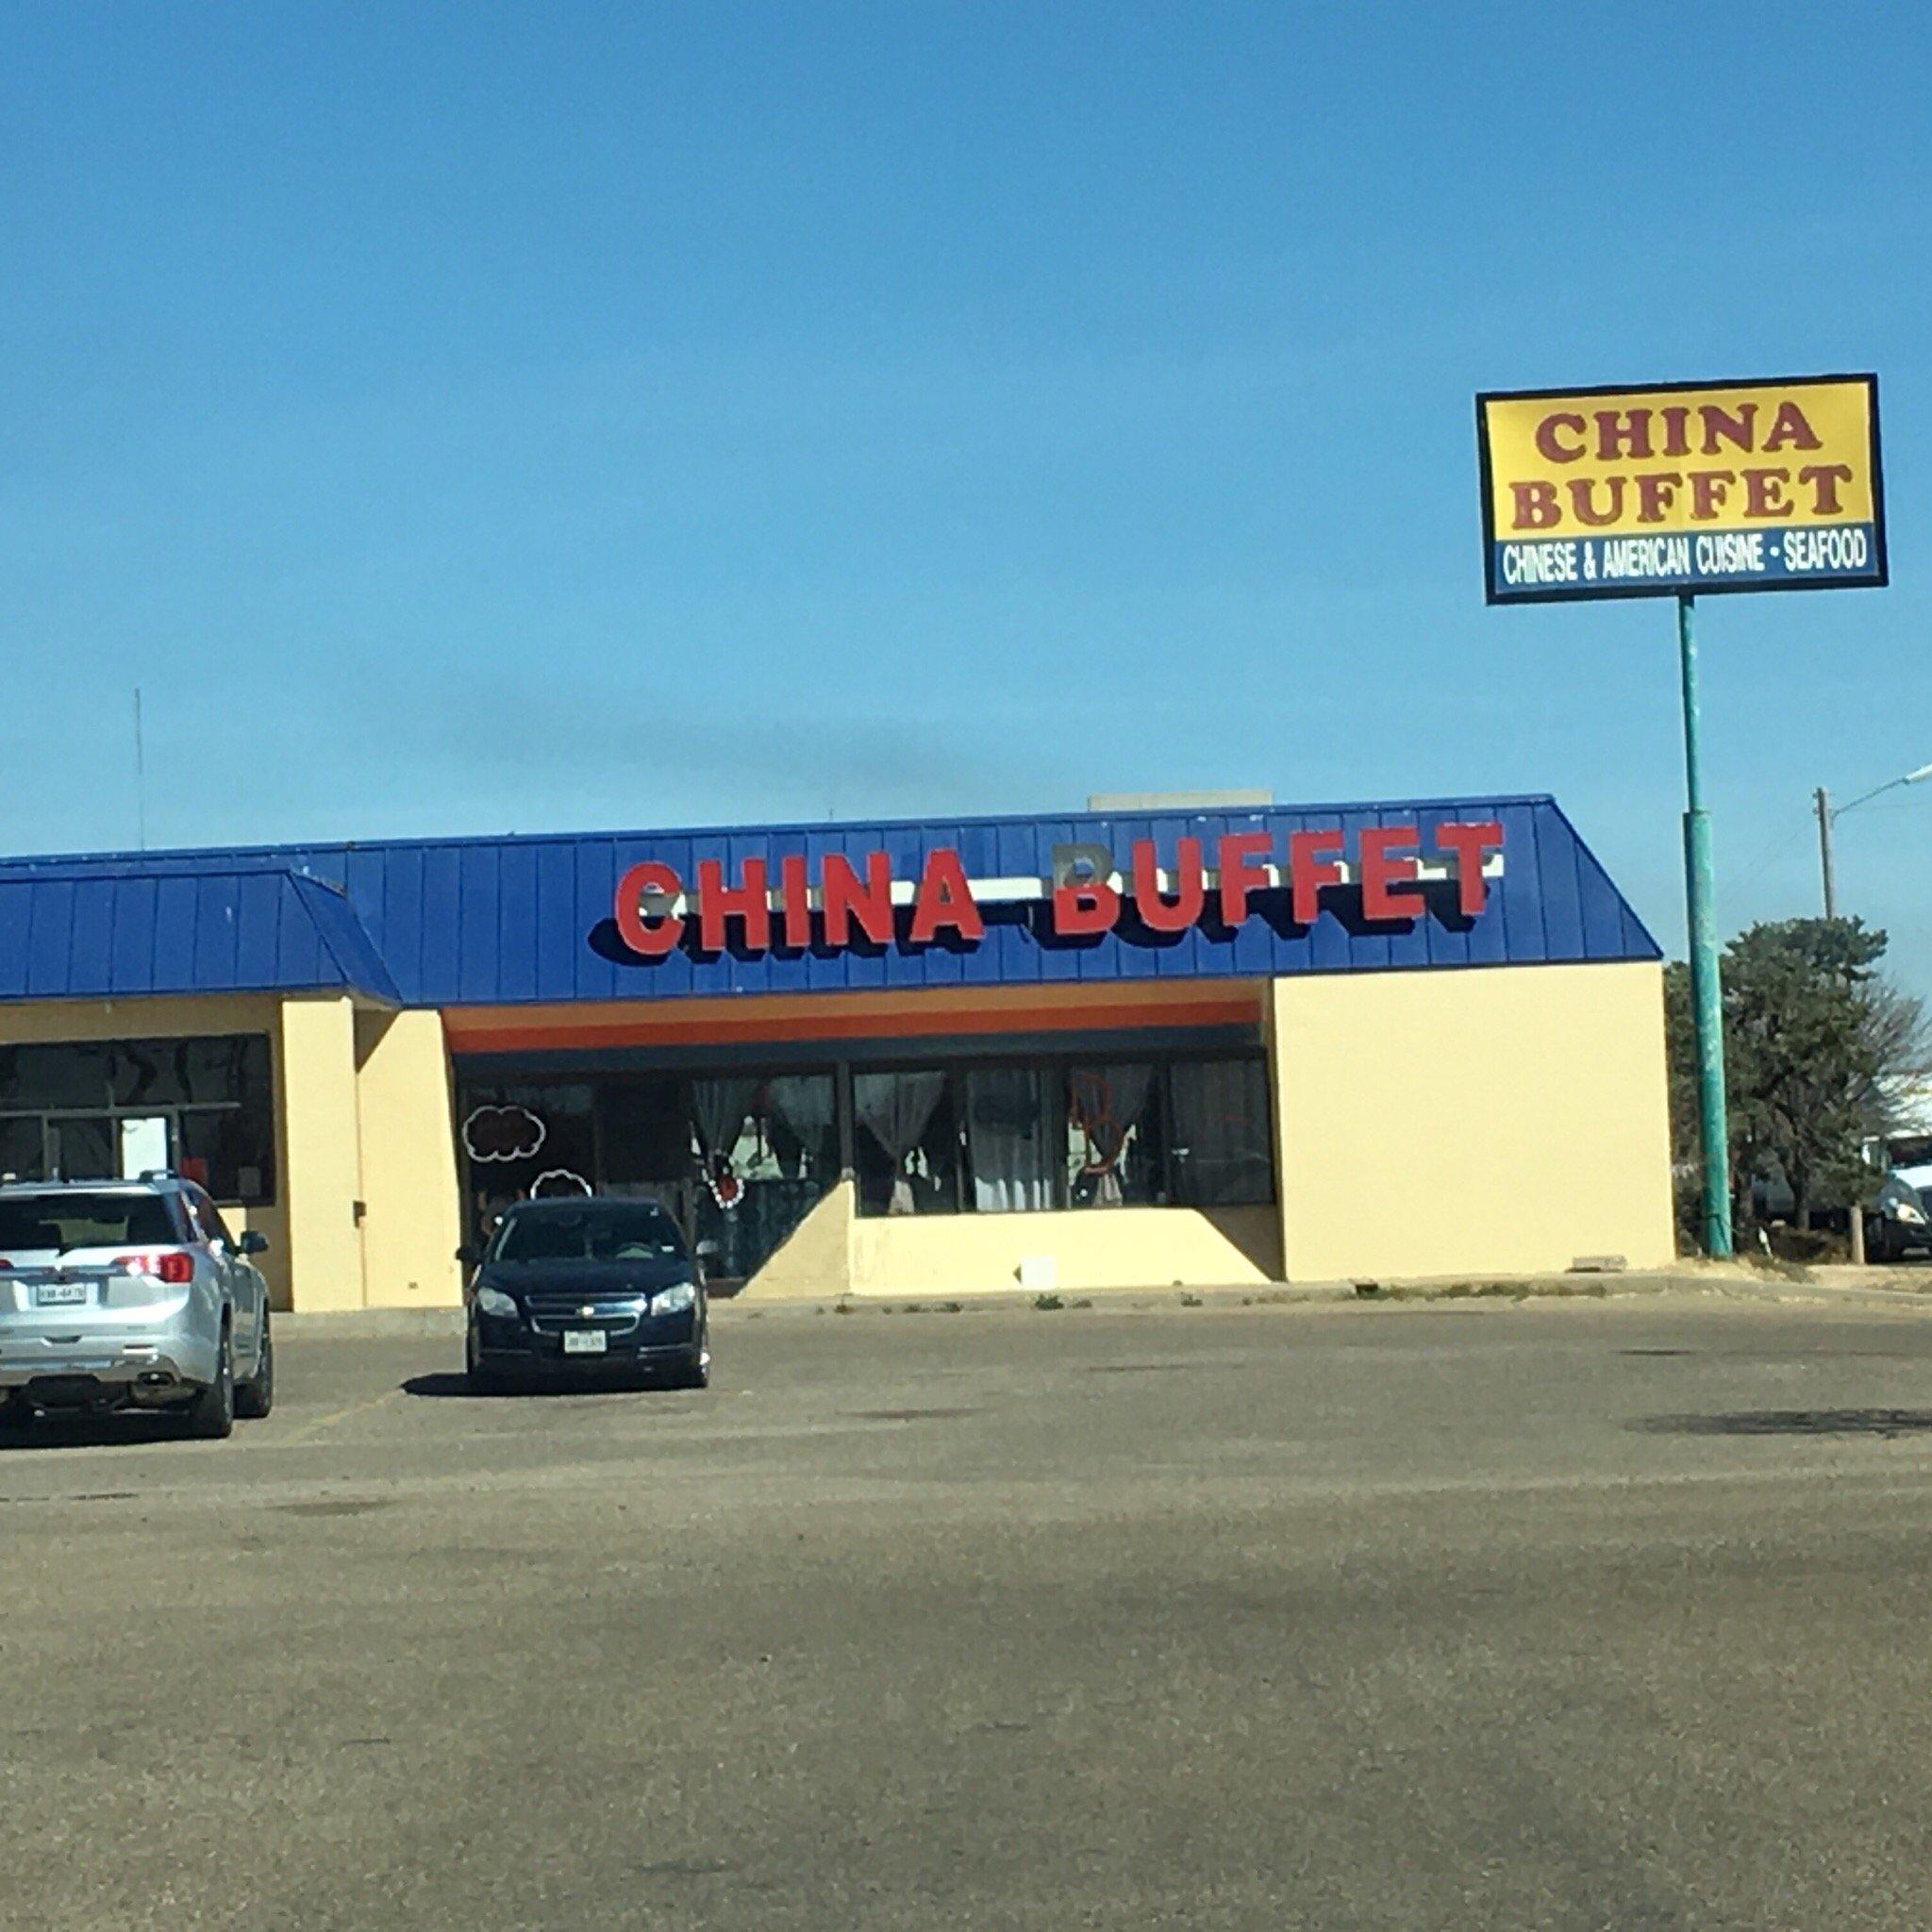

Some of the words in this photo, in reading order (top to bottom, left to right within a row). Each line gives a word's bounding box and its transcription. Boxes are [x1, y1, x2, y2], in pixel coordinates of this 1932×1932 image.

[1535, 402, 1823, 463] CHINA
[1508, 464, 1853, 530] BUFFET
[1503, 541, 1578, 584] CHINESE
[1583, 541, 1597, 580] &
[1603, 537, 1690, 577] AMERICAN
[1696, 533, 1765, 575] CUISINE
[1783, 528, 1867, 572] SEAFOOD
[615, 848, 986, 955] CHINA
[1052, 821, 1504, 935] BUFFET
